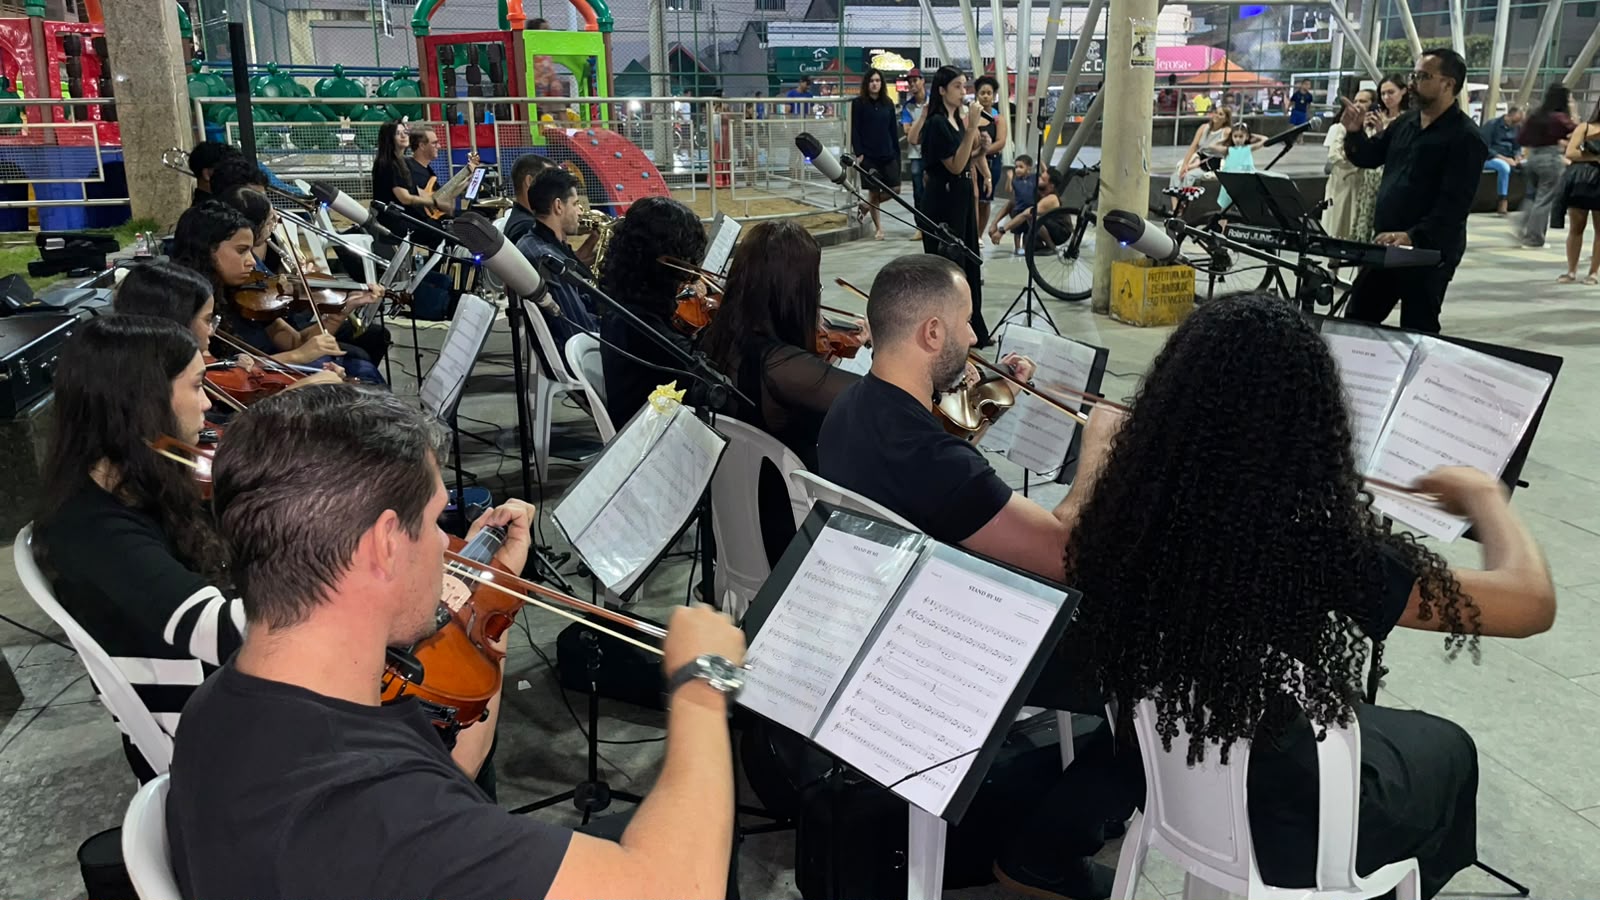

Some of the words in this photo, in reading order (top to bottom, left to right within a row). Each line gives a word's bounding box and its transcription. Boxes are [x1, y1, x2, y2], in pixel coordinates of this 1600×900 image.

[1228, 228, 1250, 240] Roland
[968, 584, 987, 597] STAND
[994, 595, 1003, 603] ME
